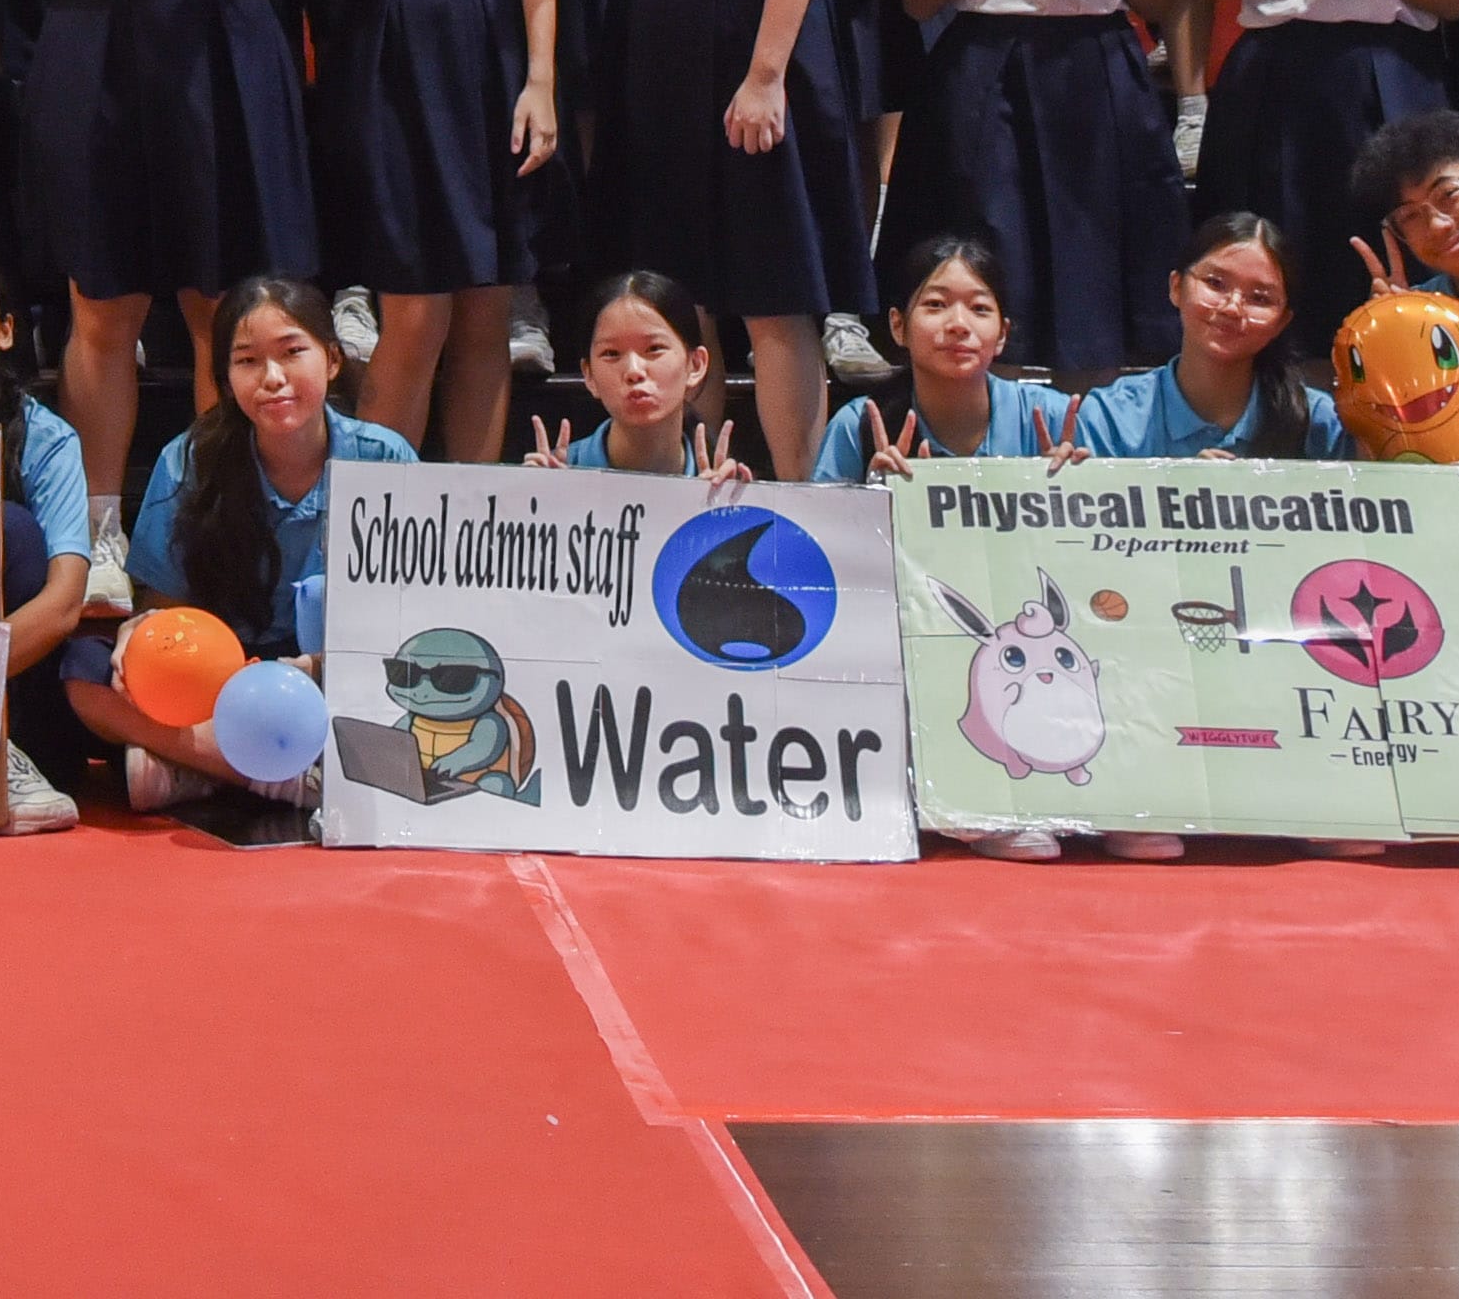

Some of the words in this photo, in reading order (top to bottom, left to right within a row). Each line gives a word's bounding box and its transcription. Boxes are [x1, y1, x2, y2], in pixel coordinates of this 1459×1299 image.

[926, 484, 1146, 533] Physical
[1160, 485, 1415, 536] Education
[347, 492, 450, 590] School
[454, 495, 559, 593] admin
[566, 503, 646, 628] staff
[1091, 532, 1250, 558] Department
[555, 679, 882, 821] Water
[1188, 731, 1269, 745] WIGGLYTUFF
[1352, 742, 1417, 767] Energy
